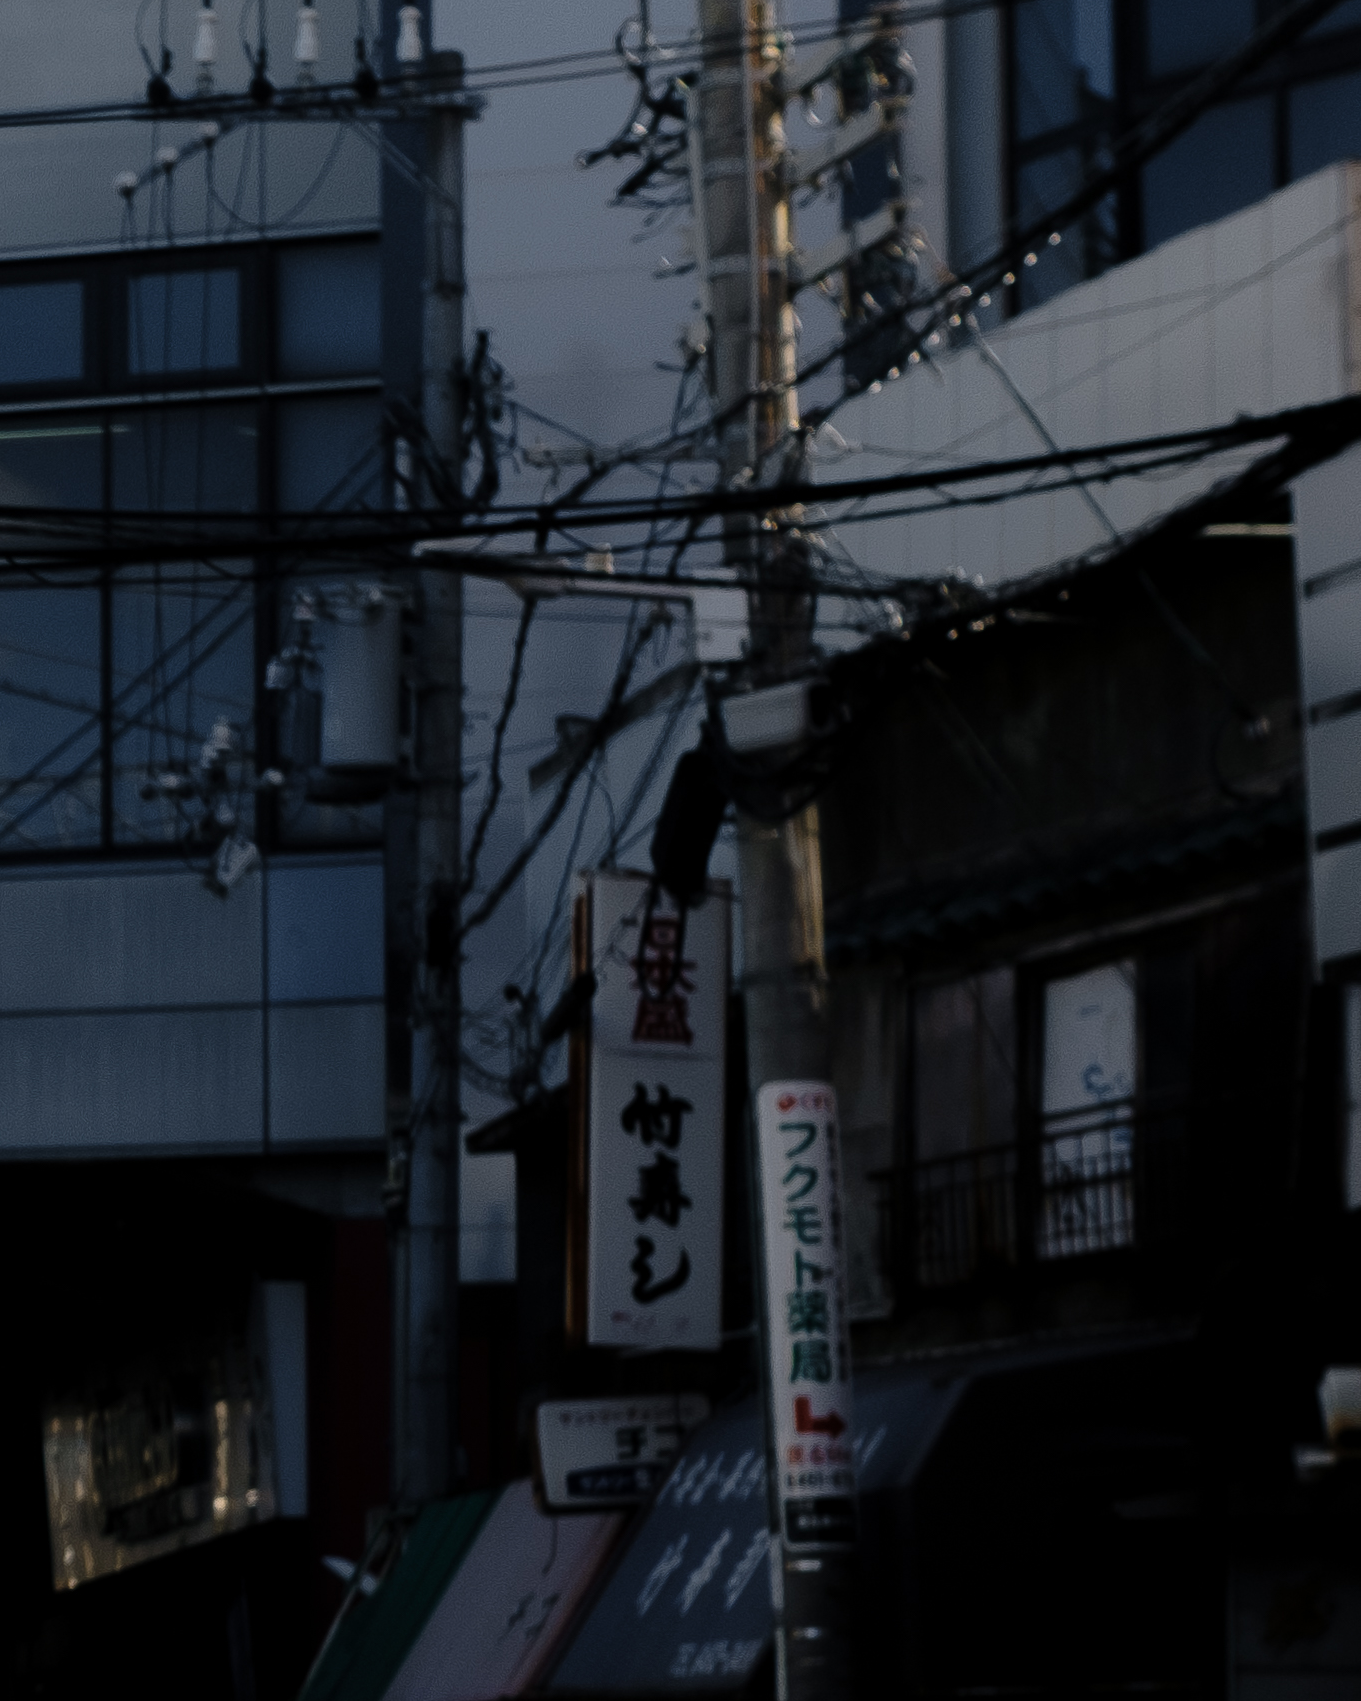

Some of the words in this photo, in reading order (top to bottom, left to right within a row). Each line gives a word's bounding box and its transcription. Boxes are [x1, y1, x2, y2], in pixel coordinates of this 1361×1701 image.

[777, 1122, 832, 1383] フクモト薬局
